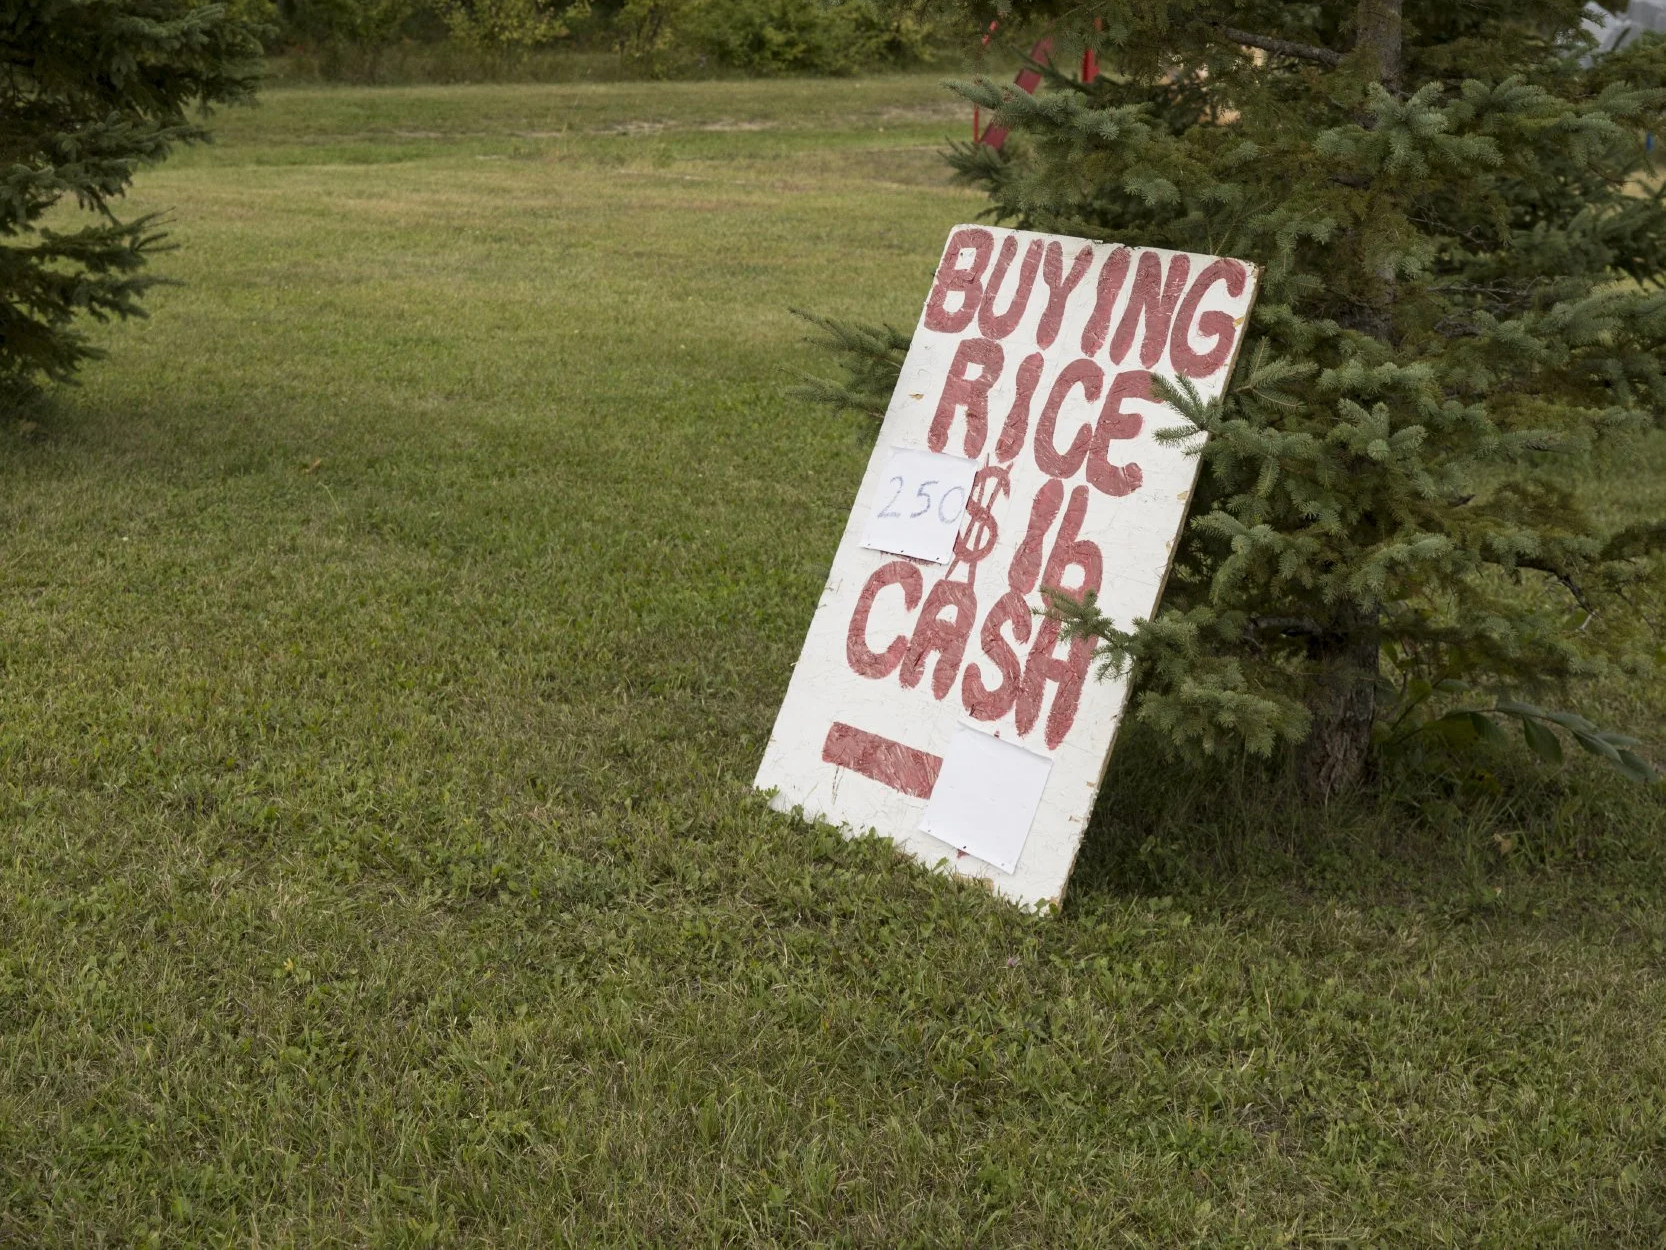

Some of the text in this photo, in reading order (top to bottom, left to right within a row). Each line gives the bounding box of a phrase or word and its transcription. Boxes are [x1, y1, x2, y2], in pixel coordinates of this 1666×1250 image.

[923, 227, 1247, 379] BUYING
[927, 337, 1166, 497] RICE
[876, 475, 966, 524] 250
[846, 560, 1102, 751] CASH
